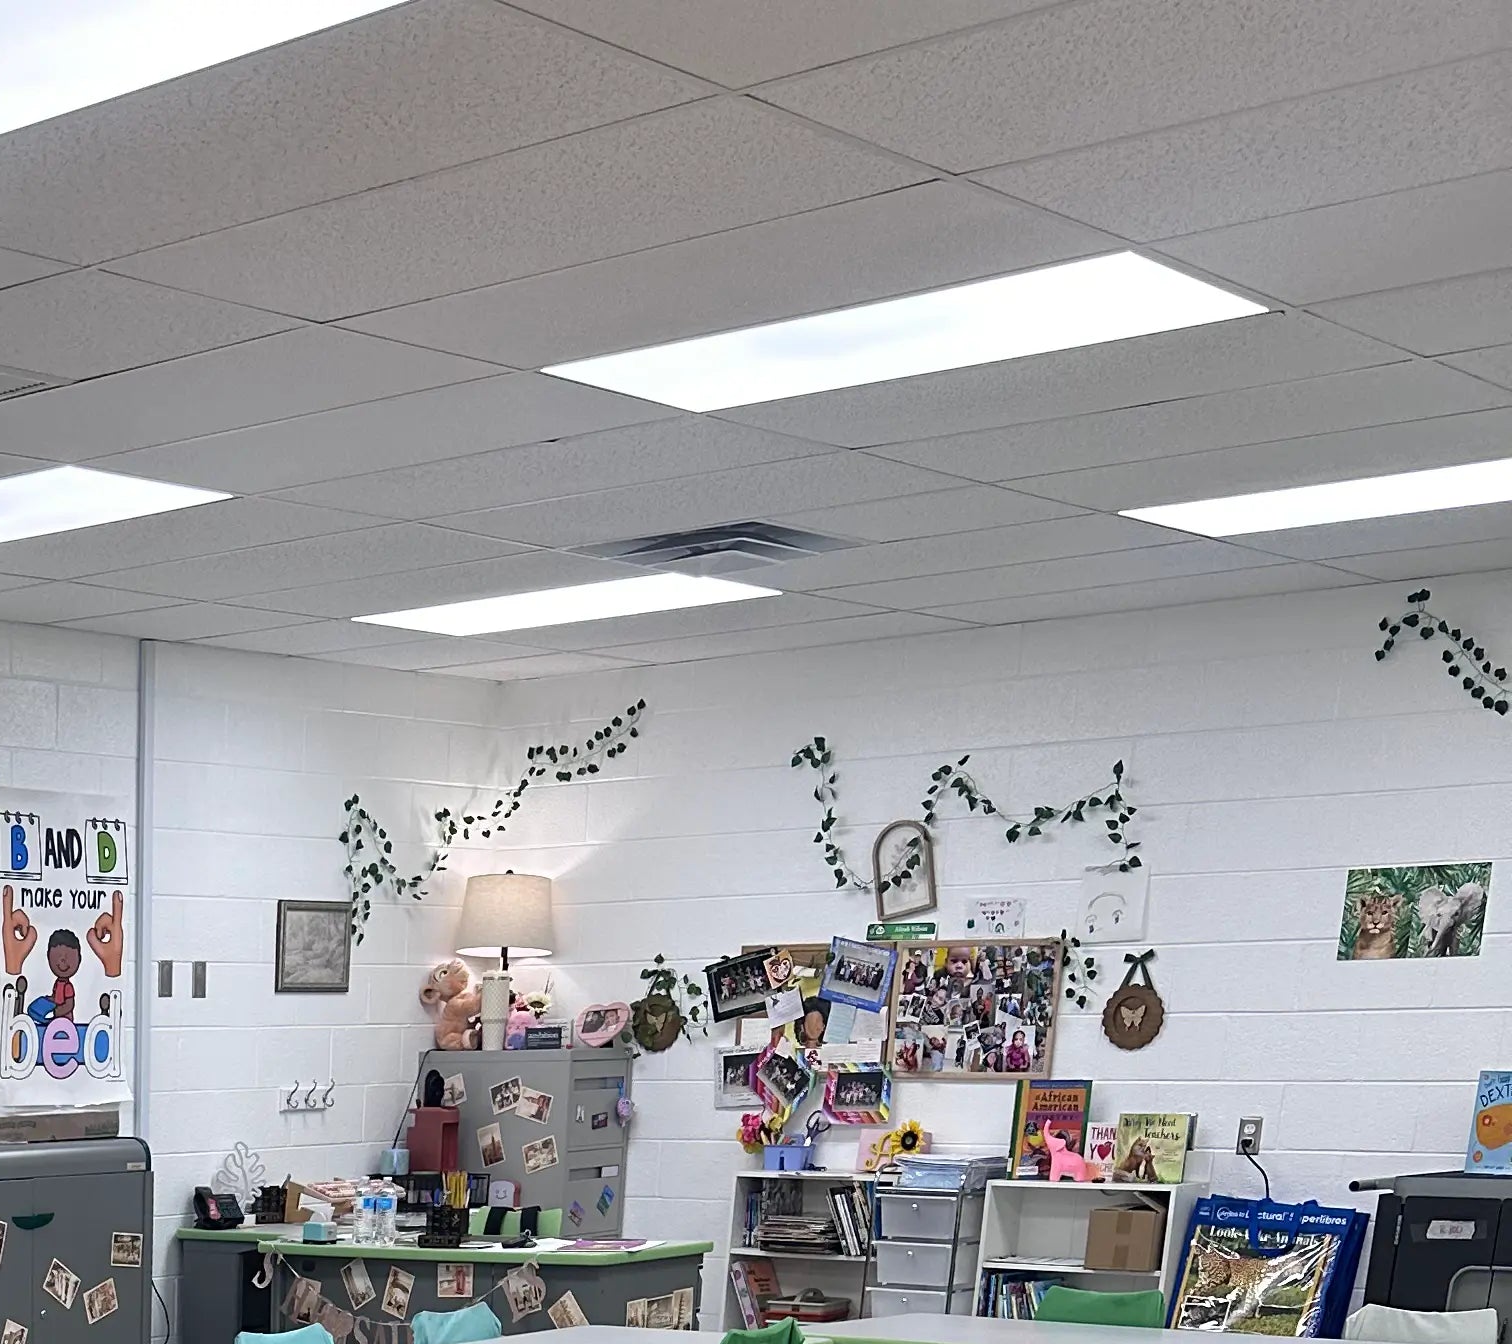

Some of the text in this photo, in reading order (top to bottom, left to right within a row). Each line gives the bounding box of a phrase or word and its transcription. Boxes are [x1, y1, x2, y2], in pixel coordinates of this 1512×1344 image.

[11, 824, 117, 873] B AND D
[21, 887, 62, 909] make
[0, 988, 122, 1080] bed
[1040, 1091, 1079, 1102] African
[1032, 1102, 1079, 1112] American
[1157, 1117, 1176, 1127] Need
[1091, 1127, 1117, 1140] THAN
[1144, 1128, 1181, 1141] Teachers
